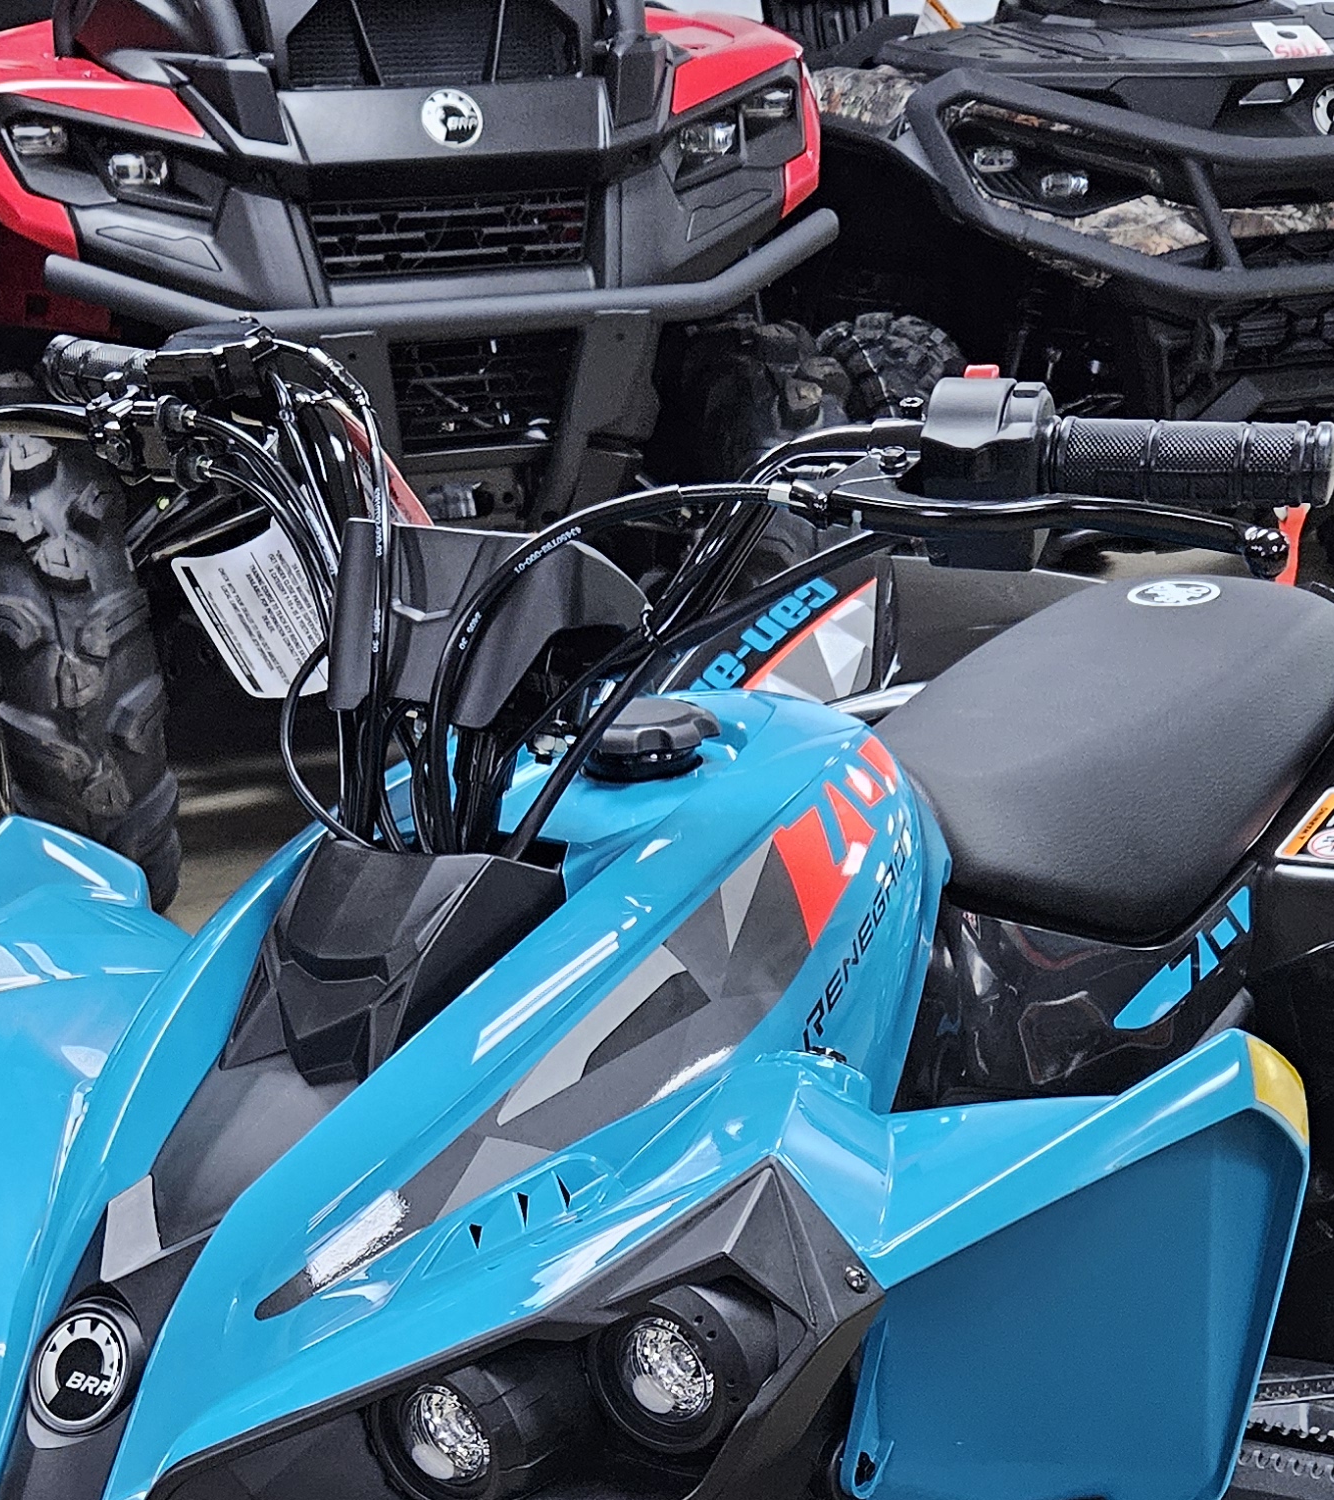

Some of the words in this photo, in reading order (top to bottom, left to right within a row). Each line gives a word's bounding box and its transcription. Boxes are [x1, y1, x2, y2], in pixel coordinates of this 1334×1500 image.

[1275, 44, 1327, 58] SALE
[802, 822, 911, 1052] RENEGAD
[66, 1371, 114, 1397] BRP
